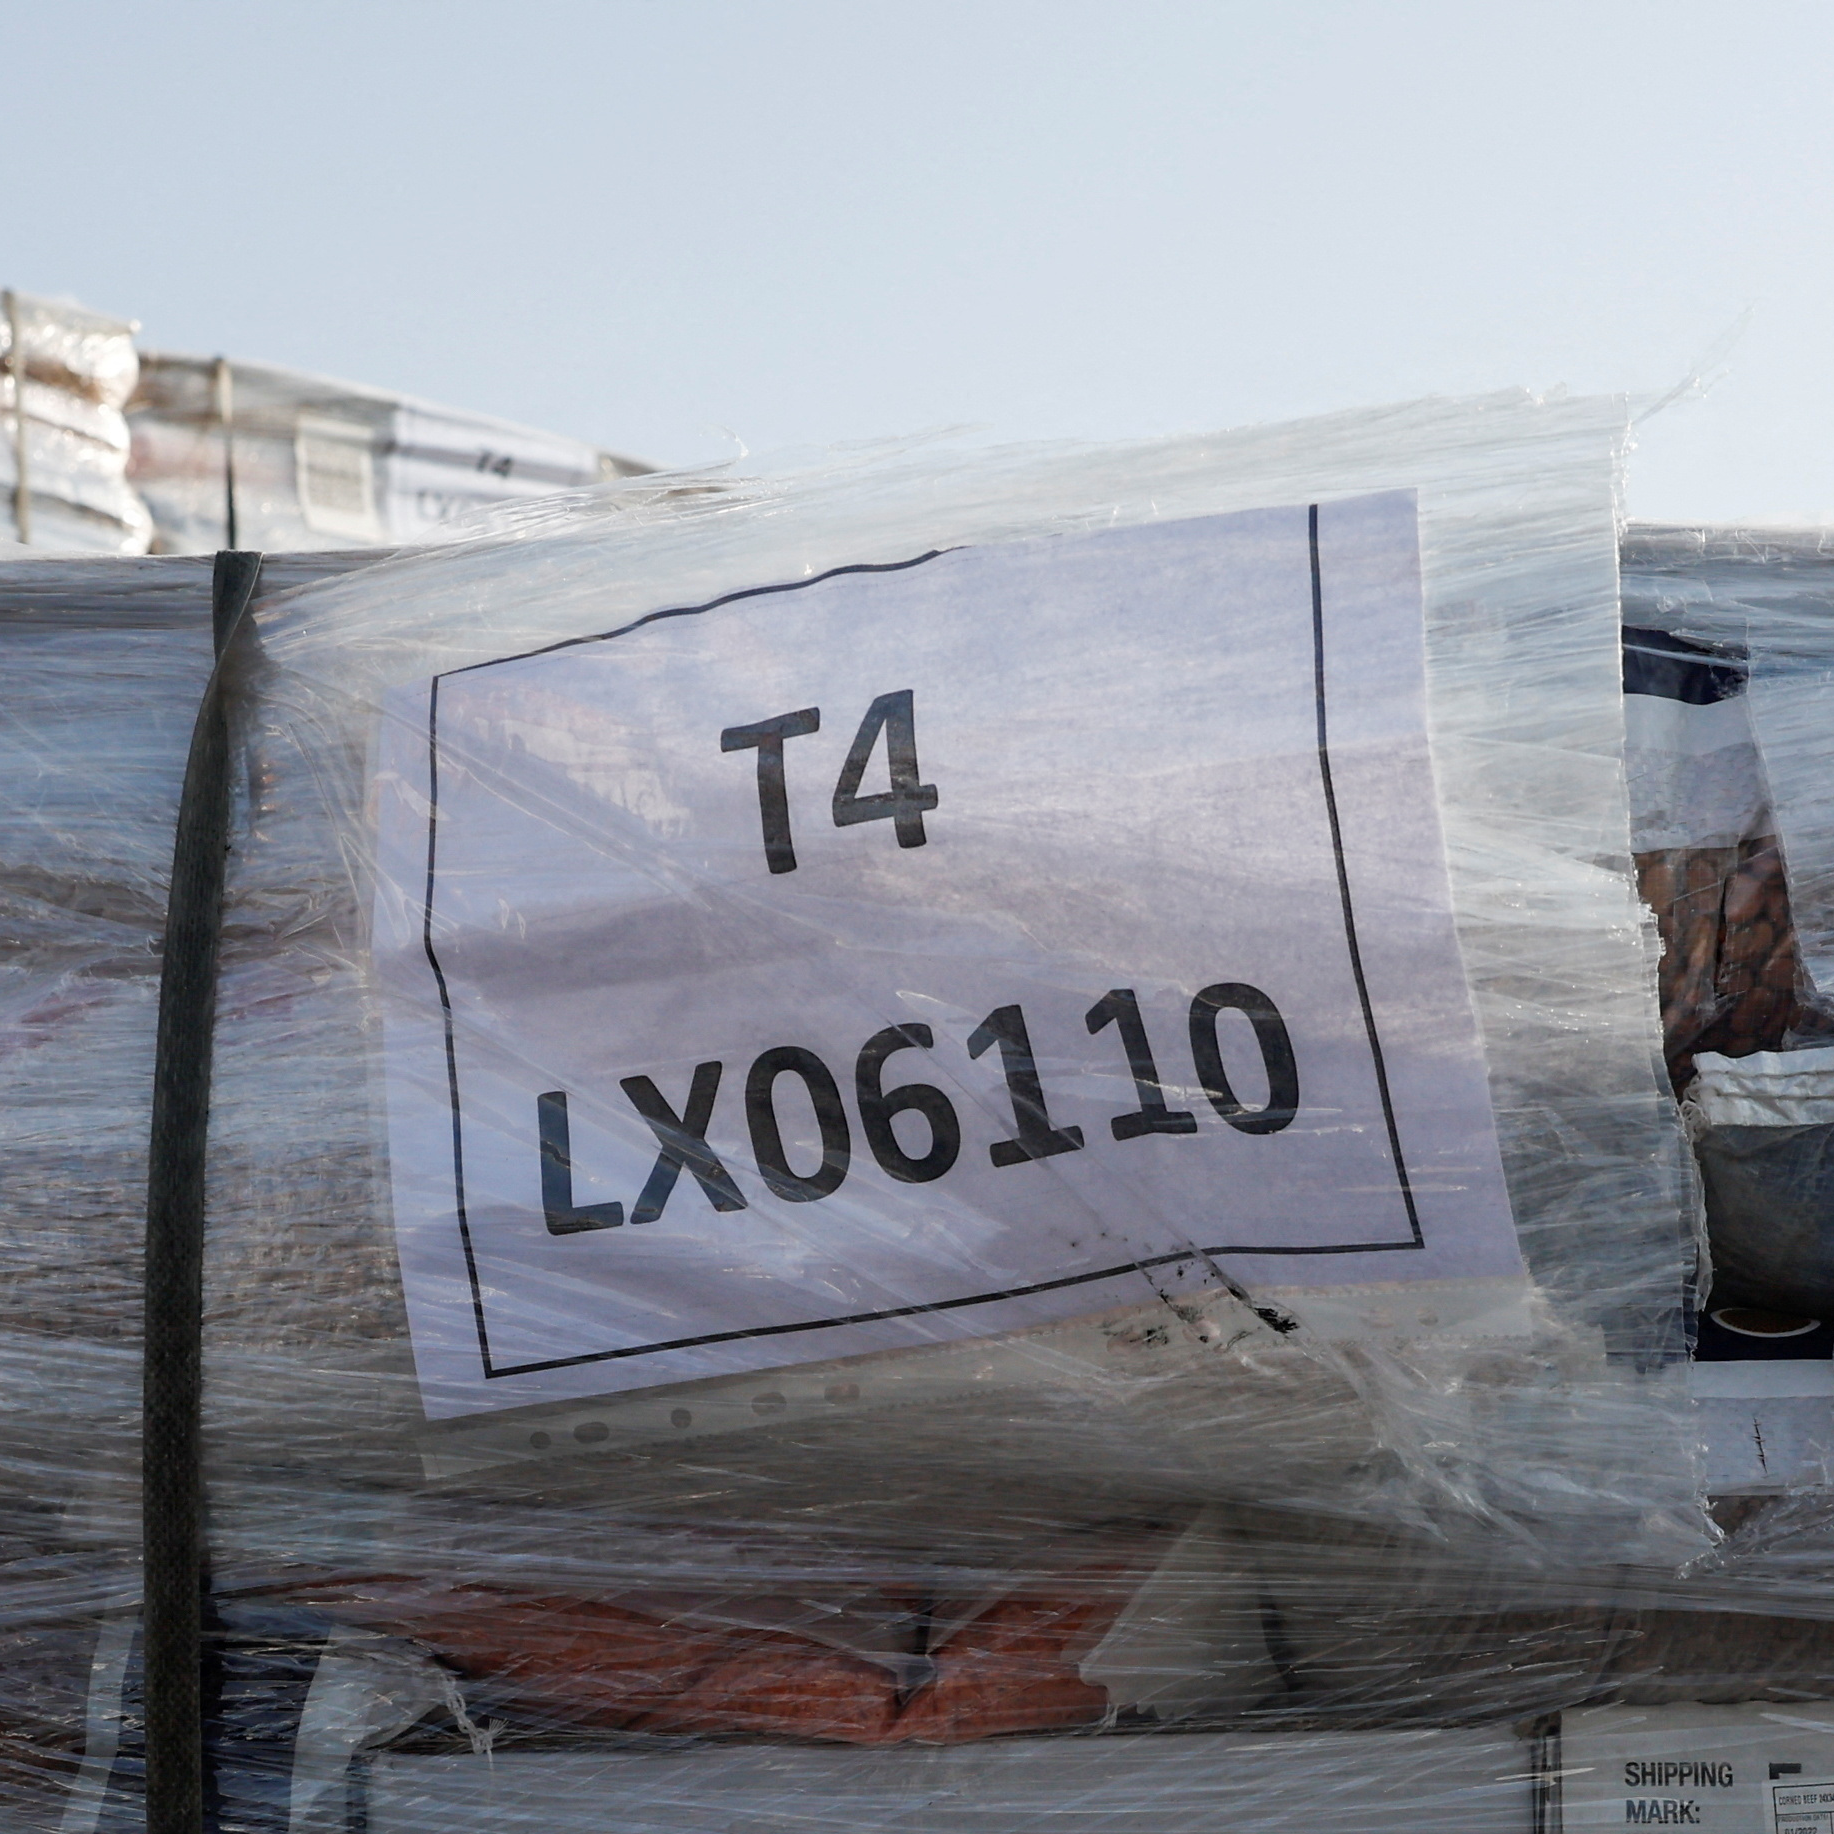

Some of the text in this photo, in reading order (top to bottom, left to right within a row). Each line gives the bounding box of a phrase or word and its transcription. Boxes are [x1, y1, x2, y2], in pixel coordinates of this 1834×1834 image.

[721, 688, 939, 875] T4
[538, 982, 1300, 1236] LX06110
[1624, 1761, 1734, 1788] SHIPPING
[1625, 1799, 1701, 1824] MARK:
[1803, 1793, 1818, 1804] BEEF
